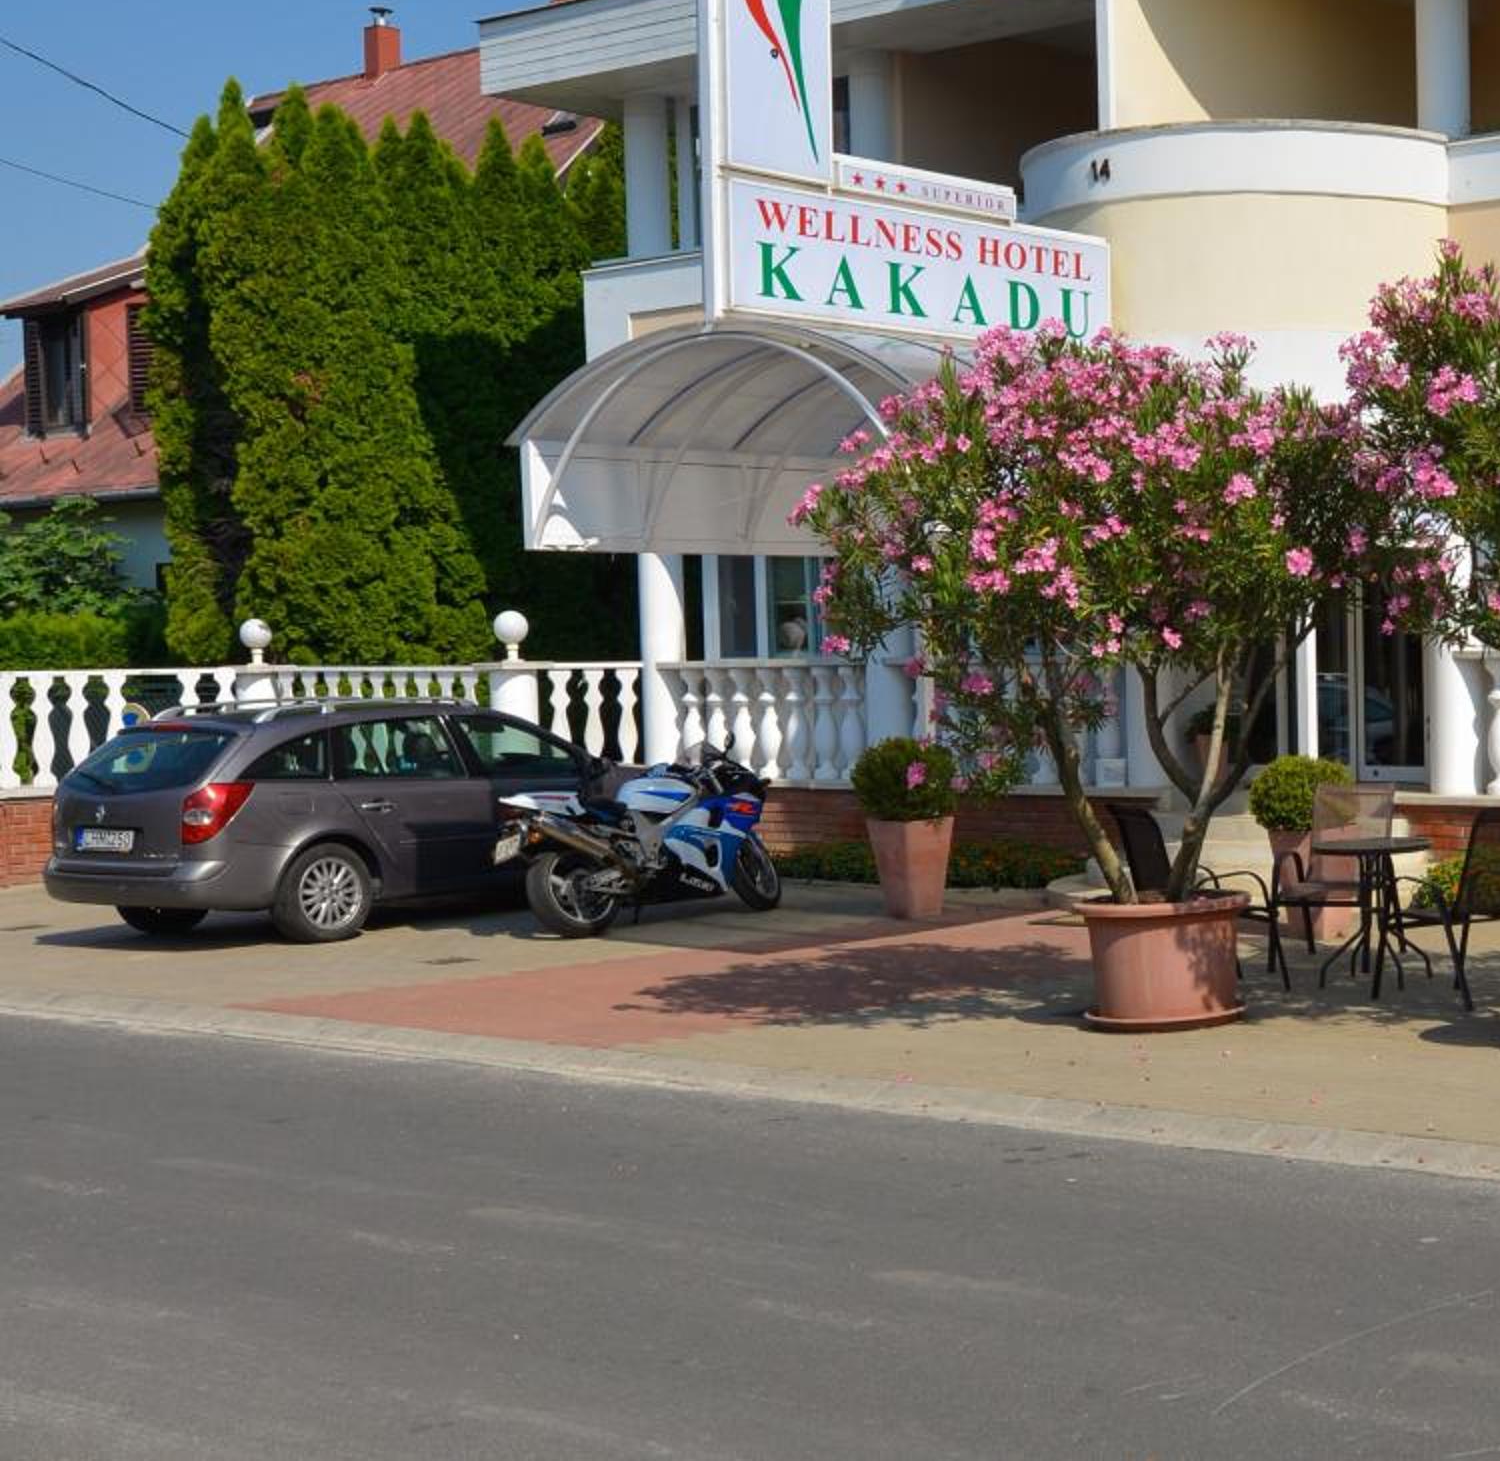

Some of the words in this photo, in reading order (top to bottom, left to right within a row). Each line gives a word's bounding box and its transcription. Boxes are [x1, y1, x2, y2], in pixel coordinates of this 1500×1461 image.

[1090, 158, 1111, 182] 14
[921, 185, 1005, 211] SUPERIOR
[755, 198, 963, 261] WELLNESS
[977, 235, 1092, 282] HOTEL
[757, 240, 1092, 339] KAKADU
